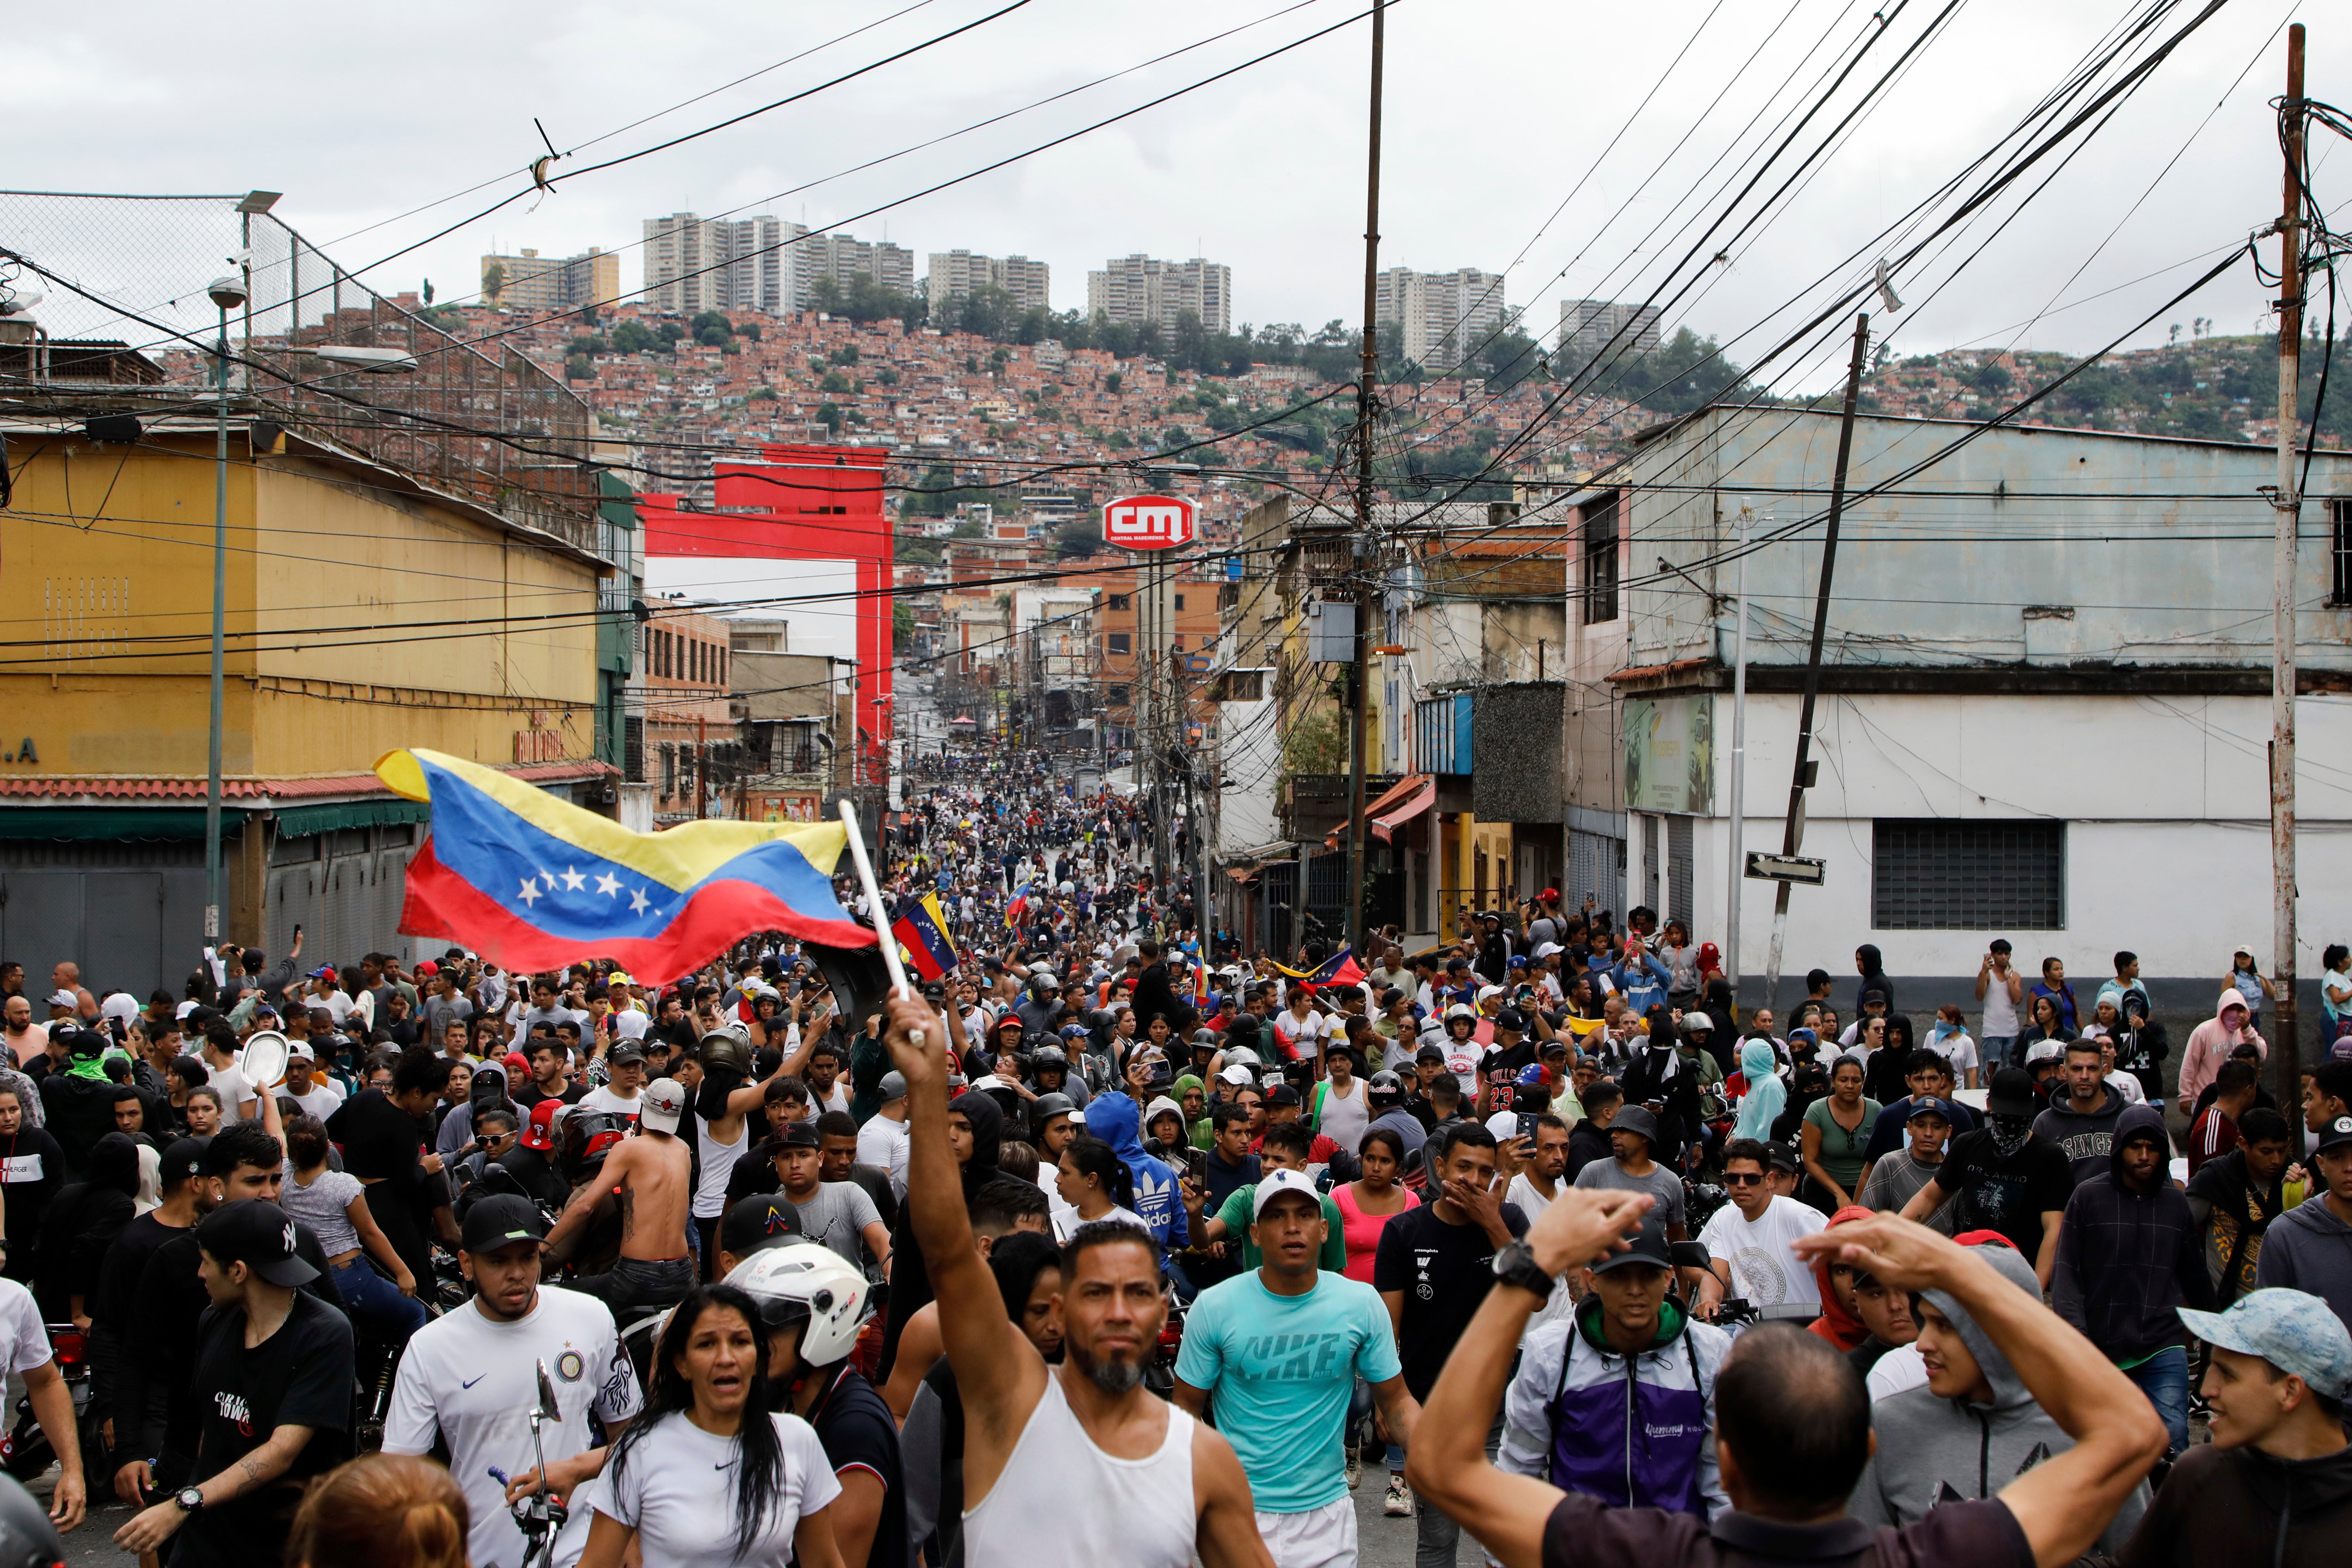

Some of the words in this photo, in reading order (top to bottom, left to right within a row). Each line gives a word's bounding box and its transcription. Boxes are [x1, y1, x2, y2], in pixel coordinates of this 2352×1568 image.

[1490, 1087, 1513, 1112] 23
[534, 1124, 544, 1136] P
[1967, 1164, 2027, 1184] ORLANDO
[1236, 1333, 1341, 1381] NIKE
[1313, 1370, 1333, 1378] AIR
[1646, 1425, 1683, 1438] Yummy
